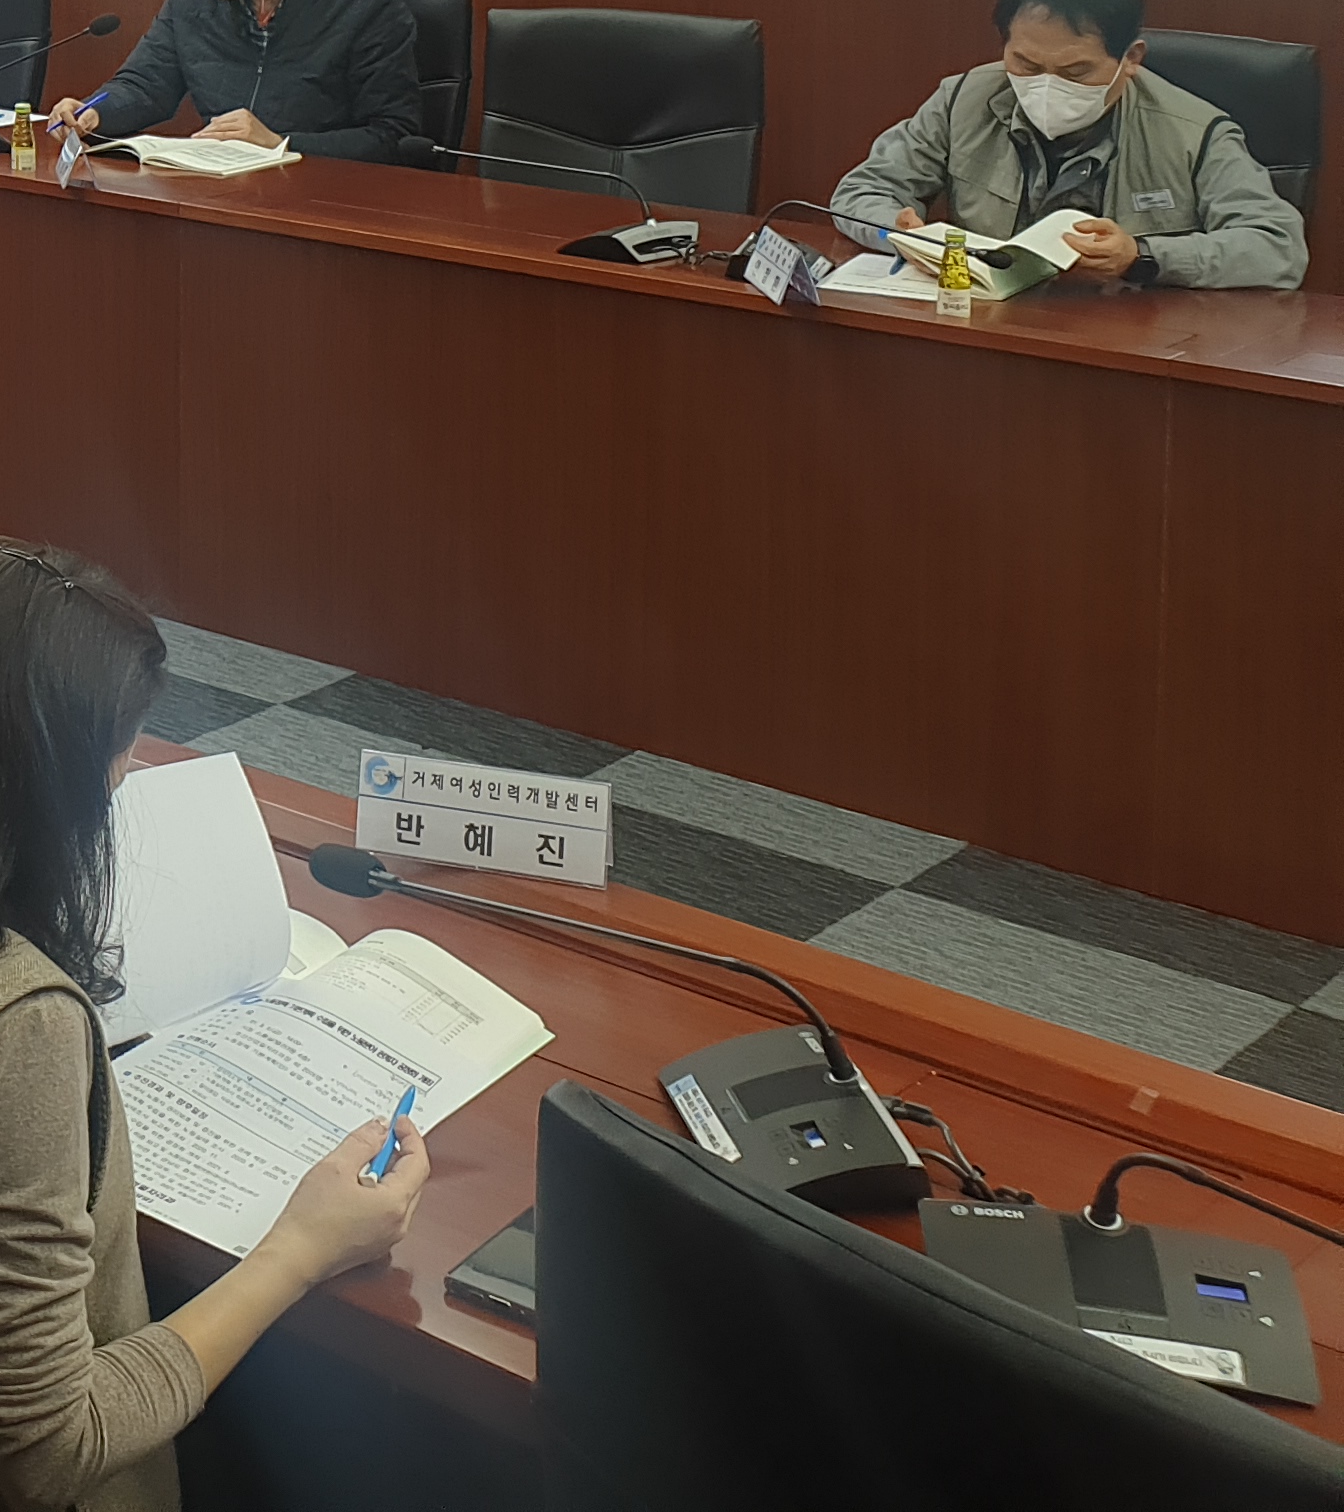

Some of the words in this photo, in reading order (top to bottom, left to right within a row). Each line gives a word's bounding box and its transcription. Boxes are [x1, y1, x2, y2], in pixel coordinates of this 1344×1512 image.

[411, 770, 600, 813] 거제여성인력개발센터
[394, 812, 566, 869] 반혜진
[973, 1206, 1025, 1220] BOSCH
